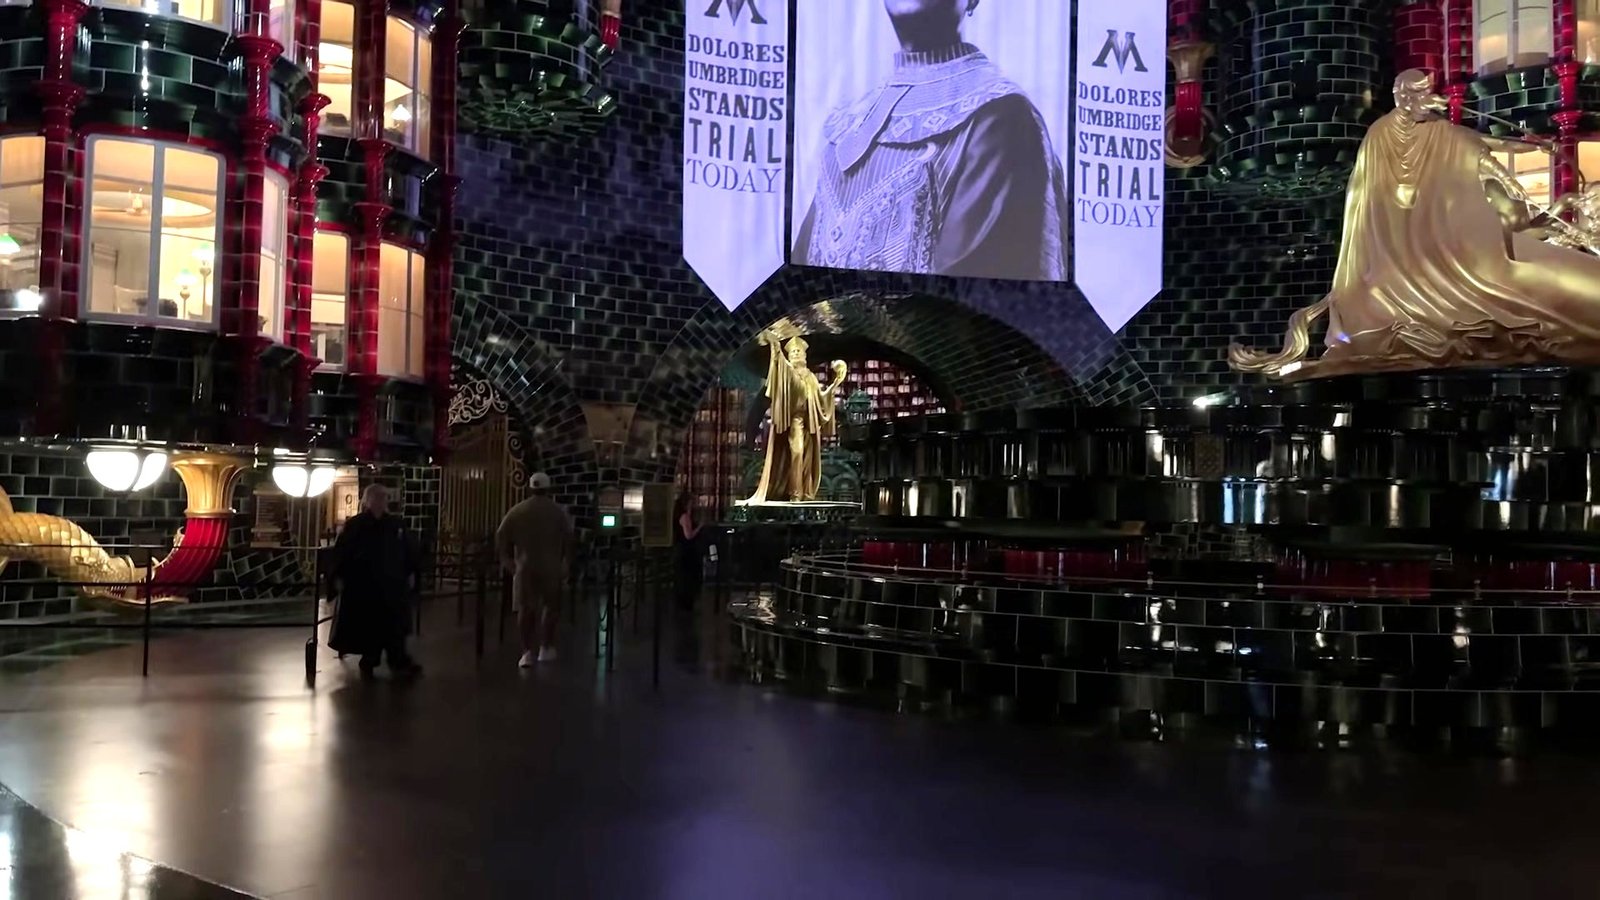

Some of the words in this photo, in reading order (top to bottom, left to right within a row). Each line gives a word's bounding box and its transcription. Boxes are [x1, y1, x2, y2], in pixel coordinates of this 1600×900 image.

[688, 33, 785, 64] DOLORES
[688, 60, 785, 90] UMBRIDGE
[688, 86, 784, 122] STANDS
[1078, 81, 1162, 108] DOLORES
[1077, 105, 1162, 132] UMBRIDGE
[688, 117, 782, 164] TRIAL
[1078, 131, 1162, 161] STANDS
[686, 158, 783, 194] TODAY
[1078, 159, 1160, 201] TRIAL
[1077, 197, 1161, 228] TODAY
